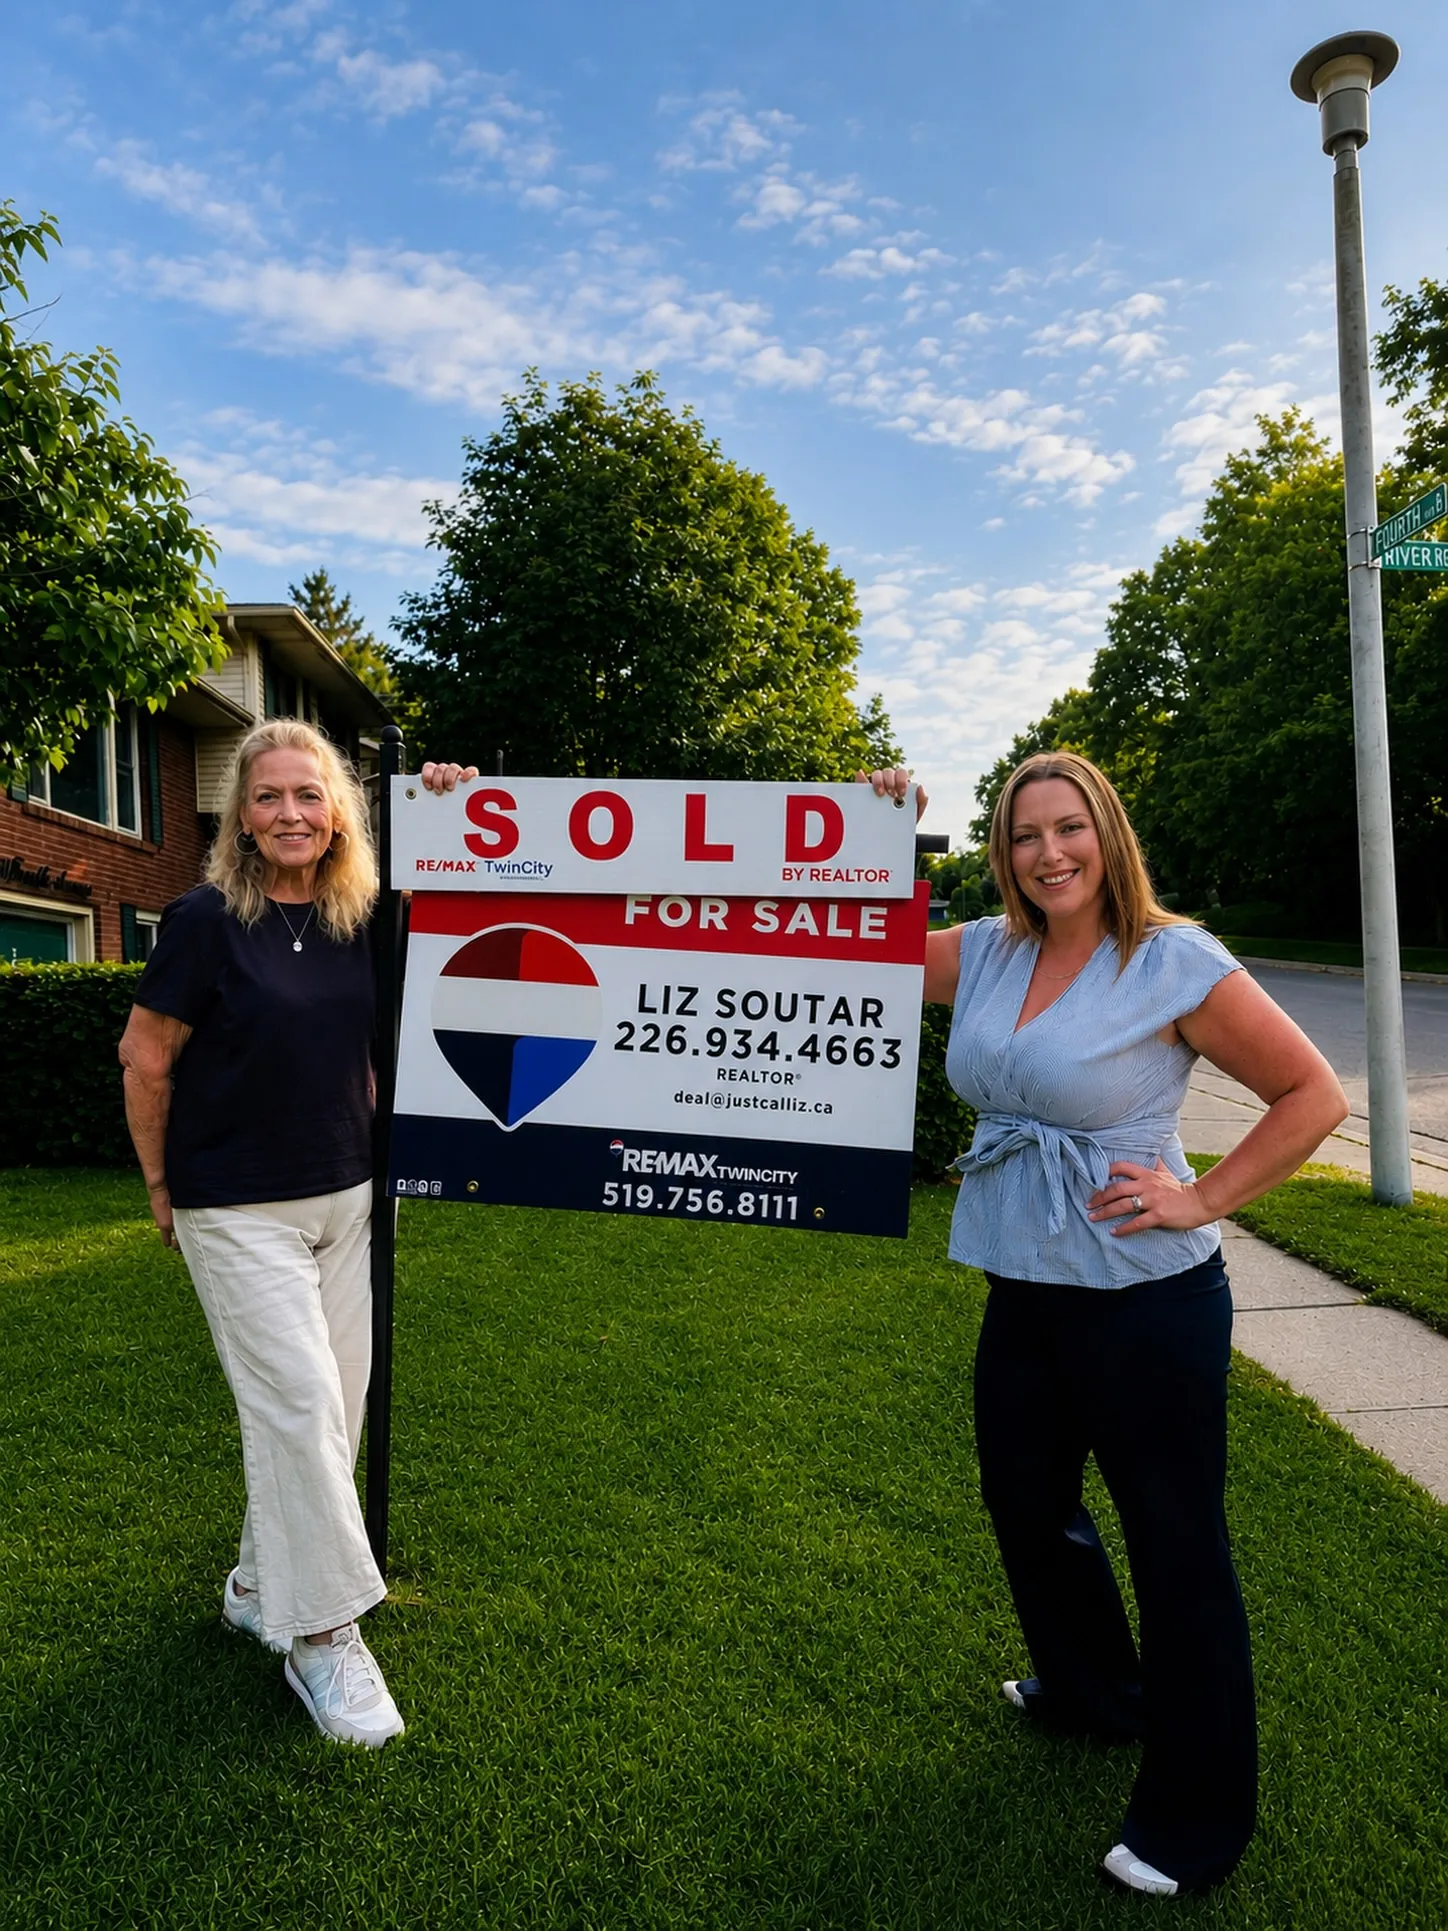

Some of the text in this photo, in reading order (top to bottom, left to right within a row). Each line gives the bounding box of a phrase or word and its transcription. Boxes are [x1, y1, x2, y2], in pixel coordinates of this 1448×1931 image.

[1375, 504, 1421, 554] FOURTH
[1385, 546, 1432, 566] RIVER
[463, 787, 845, 864] SOLD
[415, 859, 554, 878] RE/MAX TwinCity
[782, 867, 805, 881] BY
[624, 894, 889, 940] FOR SALE
[637, 983, 885, 1029] LIZ SOUTAR
[613, 1020, 903, 1070] 226.934.4663
[673, 1090, 834, 1115] deal@justcalliz.ca
[717, 1165, 799, 1185] TWINCITY
[602, 1181, 798, 1221] 519.756.8111
